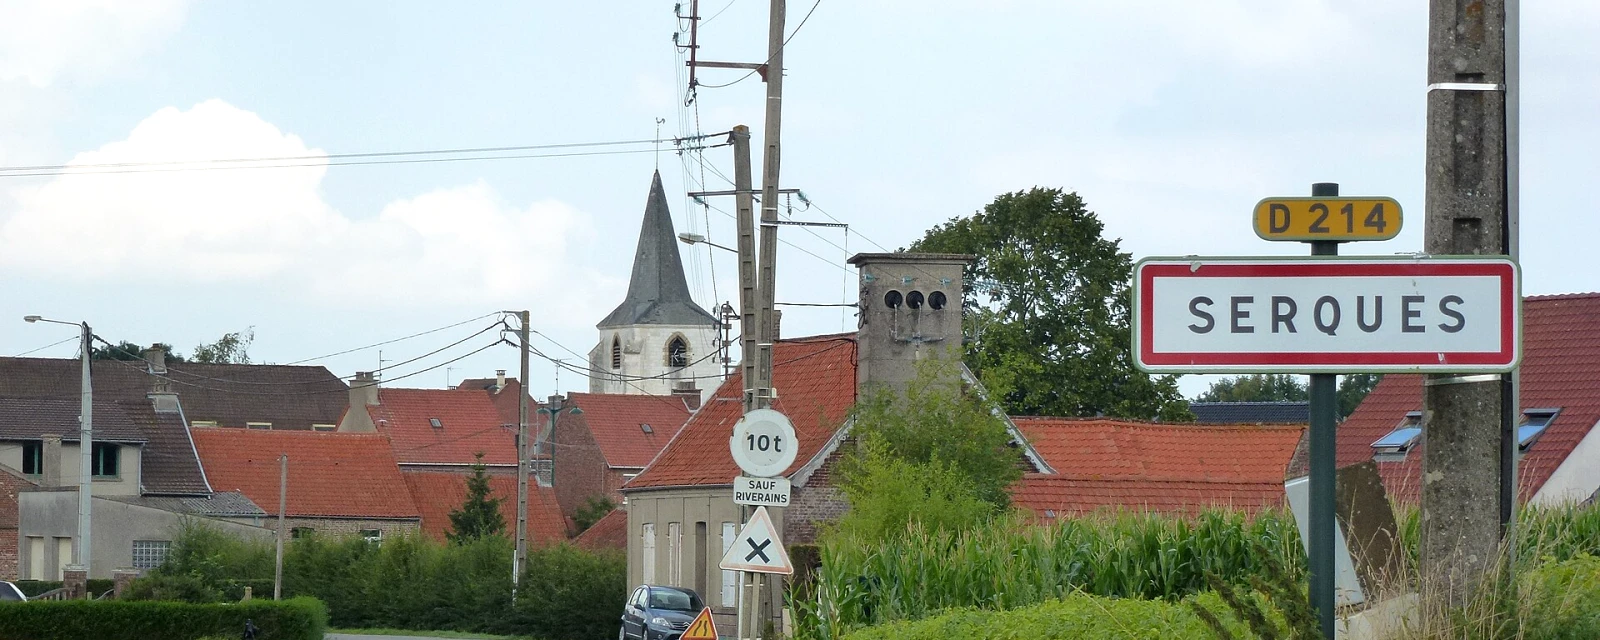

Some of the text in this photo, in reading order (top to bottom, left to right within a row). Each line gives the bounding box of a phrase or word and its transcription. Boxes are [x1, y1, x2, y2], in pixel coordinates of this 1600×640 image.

[1268, 203, 1387, 234] D 214
[1187, 294, 1466, 336] SERQUES
[748, 480, 776, 490] SAUF
[735, 491, 787, 503] RIVERAINS
